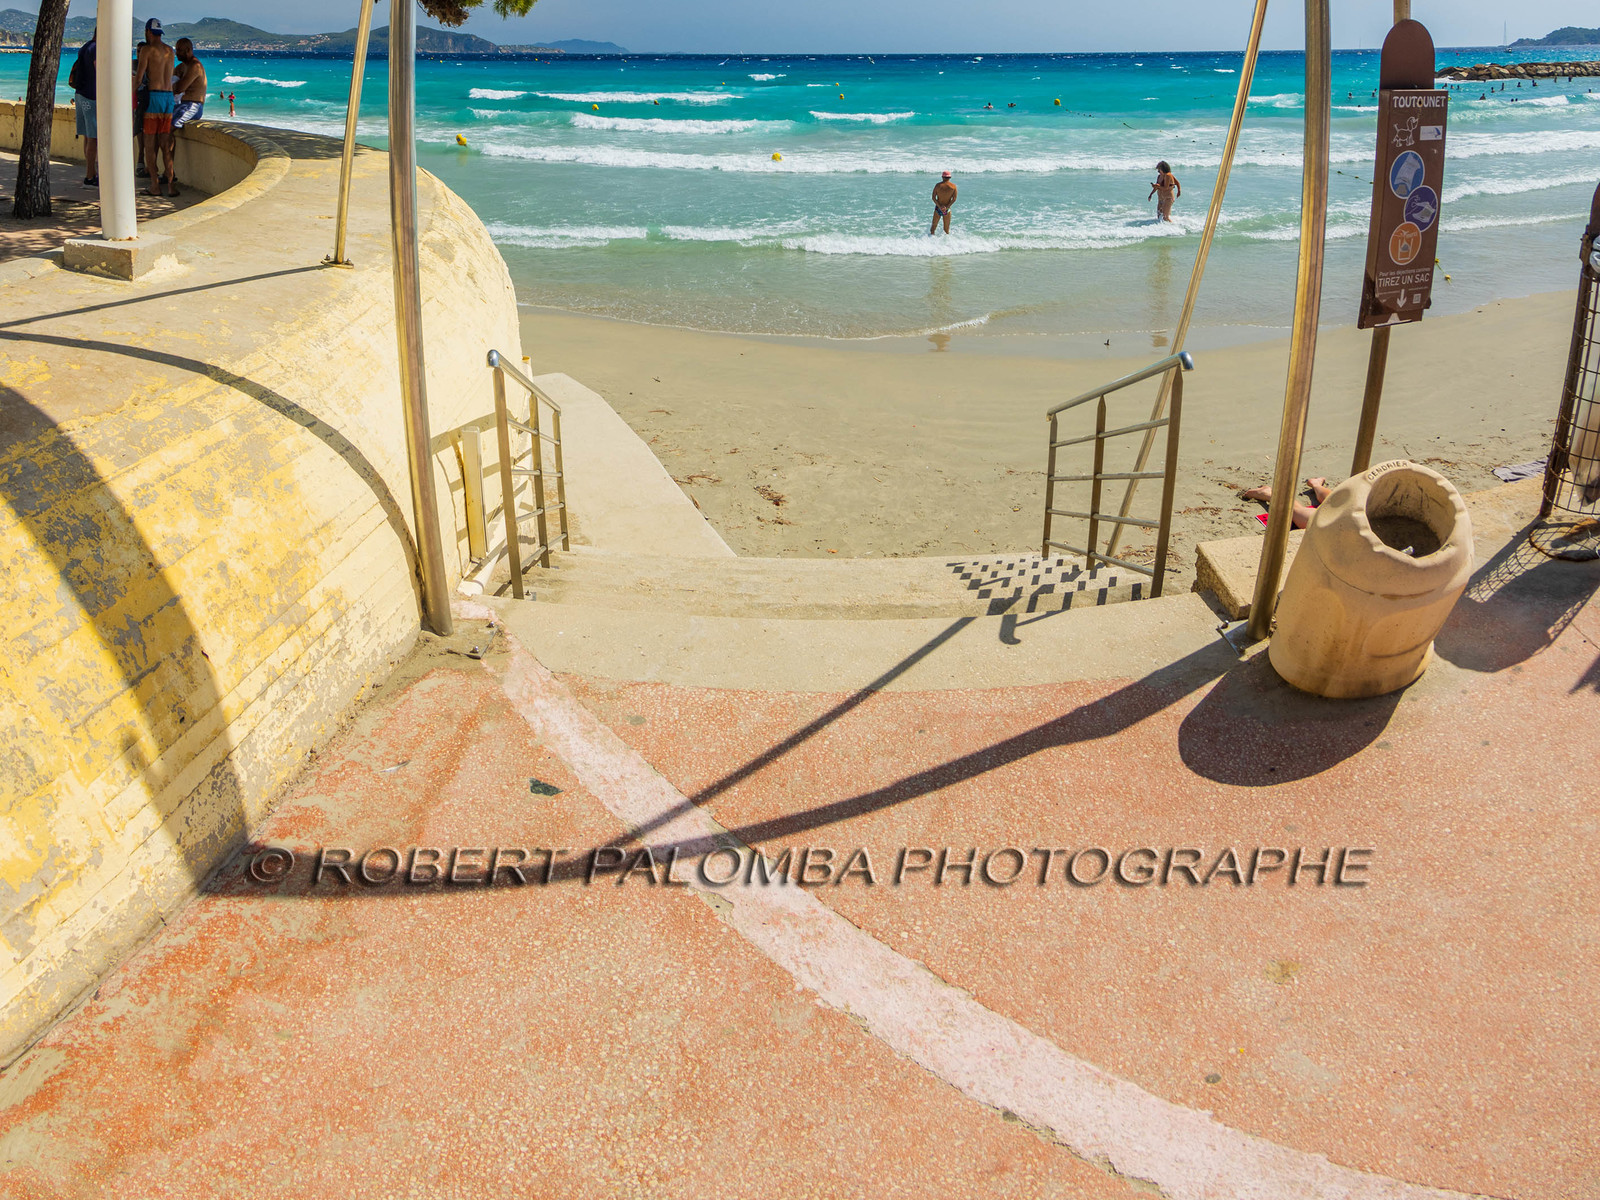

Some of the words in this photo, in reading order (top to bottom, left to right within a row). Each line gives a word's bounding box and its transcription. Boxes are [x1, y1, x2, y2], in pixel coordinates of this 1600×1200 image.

[1392, 95, 1446, 108] TOUTOUNET
[1378, 276, 1400, 288] TIREZ
[1401, 275, 1413, 285] UN
[1414, 273, 1430, 283] SAC
